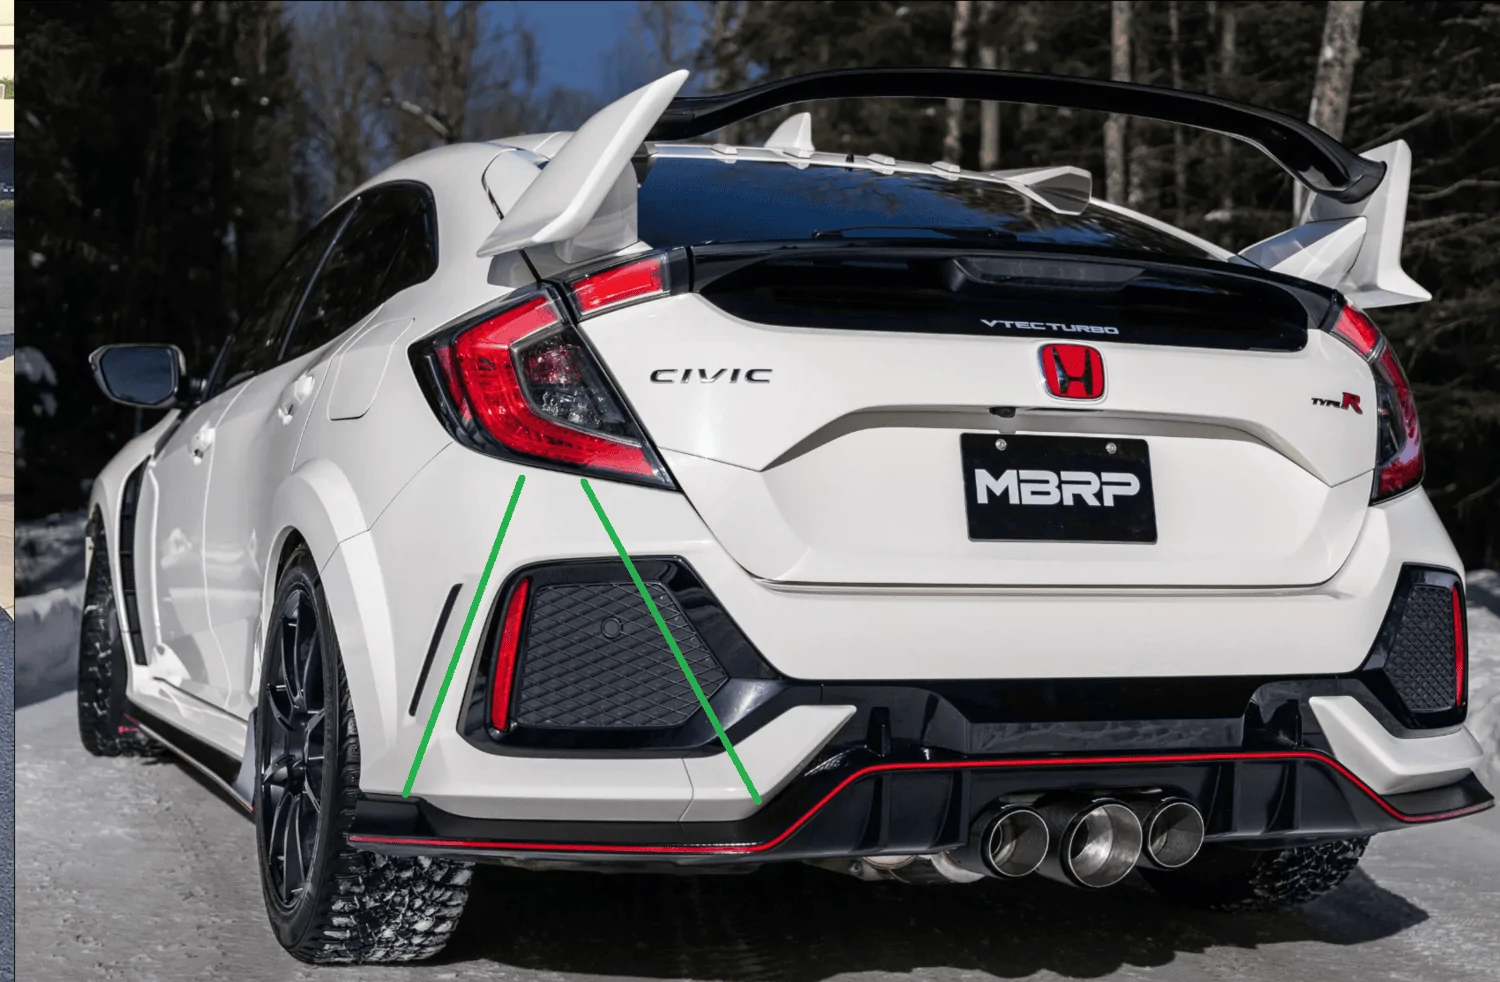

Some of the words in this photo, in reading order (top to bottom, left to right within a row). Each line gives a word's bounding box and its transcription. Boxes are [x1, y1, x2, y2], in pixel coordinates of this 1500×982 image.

[980, 319, 1046, 330] VTEC
[1045, 322, 1120, 335] TURBO
[649, 368, 773, 384] CIVIC
[974, 468, 1141, 507] MBRP
